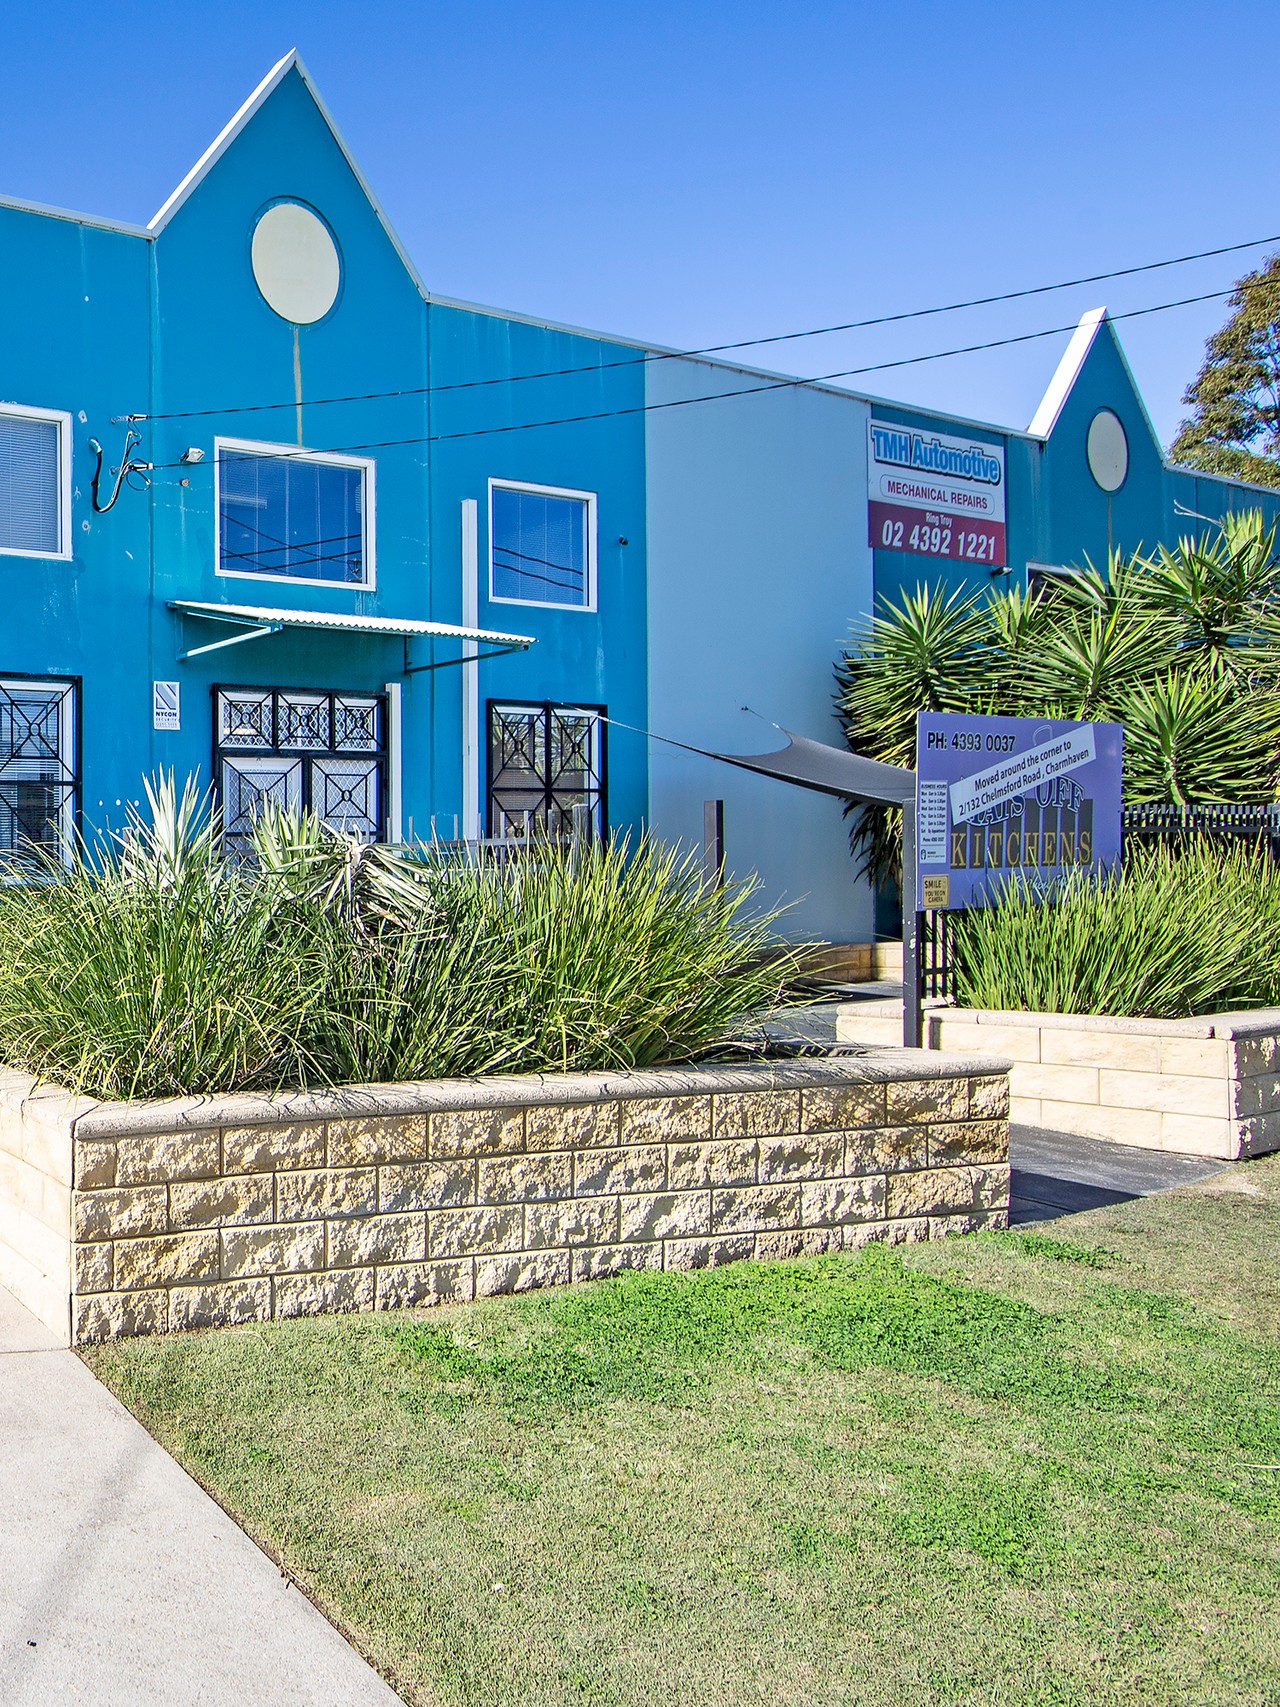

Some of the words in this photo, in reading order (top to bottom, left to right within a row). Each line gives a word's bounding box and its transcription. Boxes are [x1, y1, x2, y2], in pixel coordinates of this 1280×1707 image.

[872, 429, 910, 463] TMH
[912, 437, 999, 482] Automotive
[887, 480, 948, 503] MECHANICAL
[950, 491, 988, 509] REPAIRS
[882, 519, 904, 547] 02
[909, 525, 952, 554] 4392
[958, 531, 996, 560] 1221
[927, 732, 947, 750] PH:
[951, 733, 982, 751] 4393
[986, 734, 1016, 752] 0037
[958, 797, 981, 816] 2/132
[981, 776, 1022, 805] Chelmsford
[1045, 749, 1089, 775] Charmhaven
[974, 769, 999, 792] Moved
[1000, 757, 1026, 780] around
[1026, 754, 1039, 768] the
[1040, 744, 1062, 761] corner
[1063, 740, 1072, 751] to
[951, 831, 1092, 867] KITCHENS
[924, 880, 942, 889] SMILE
